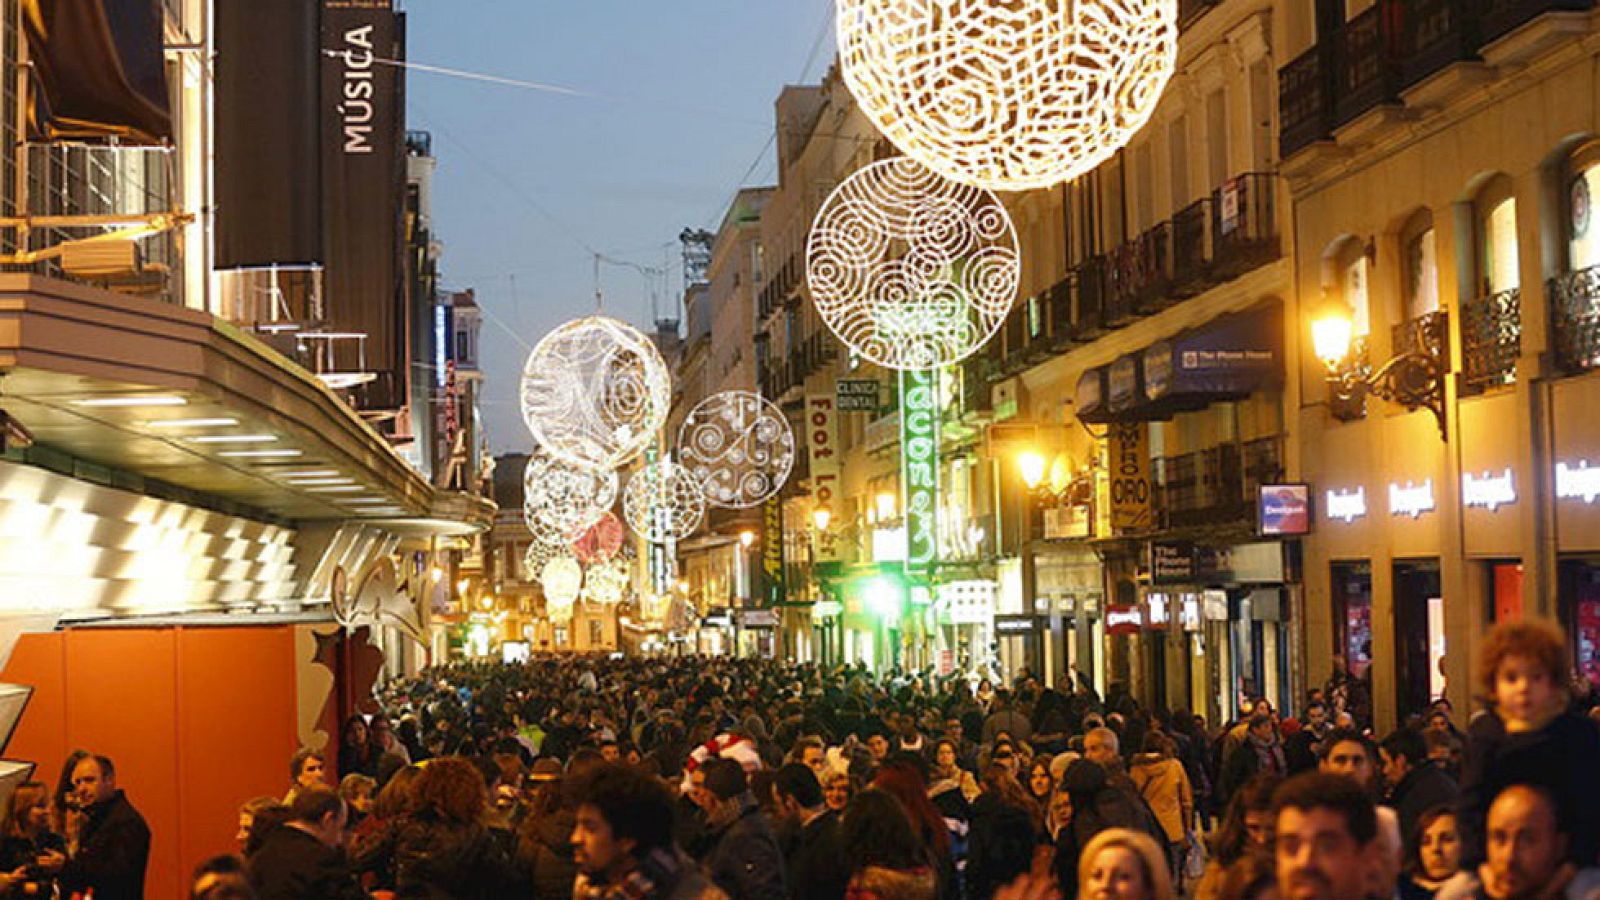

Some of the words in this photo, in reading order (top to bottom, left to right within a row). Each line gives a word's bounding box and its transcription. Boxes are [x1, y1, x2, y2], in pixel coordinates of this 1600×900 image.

[337, 24, 373, 153] MÚSICA
[811, 399, 833, 459] Foot
[1115, 479, 1146, 504] ORO
